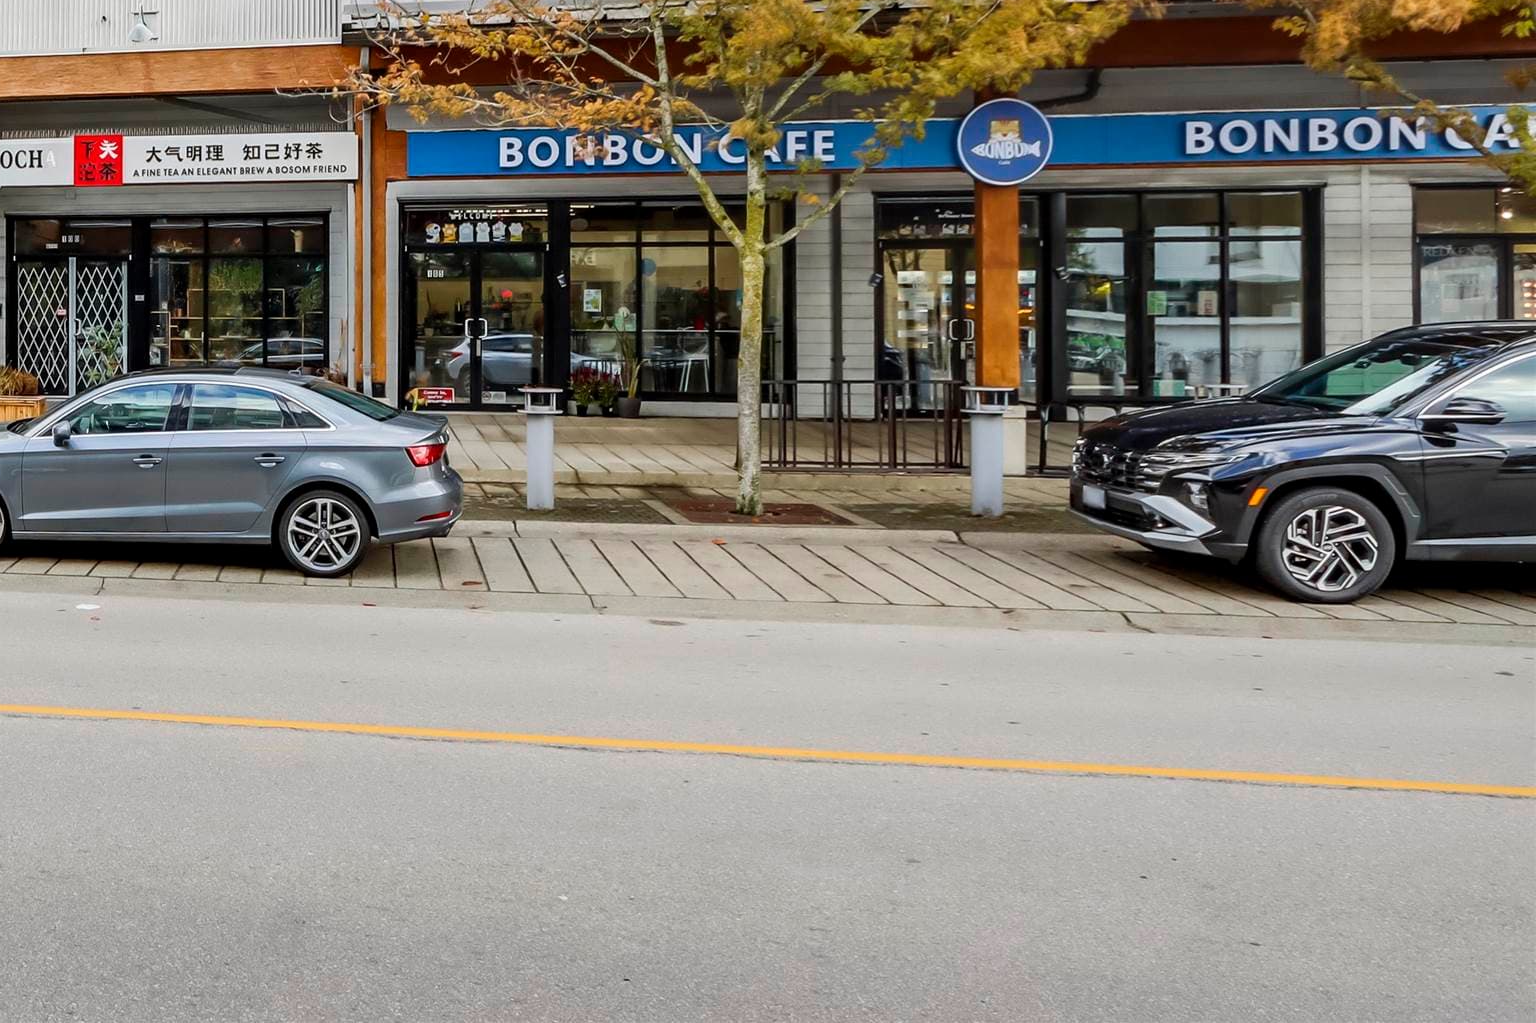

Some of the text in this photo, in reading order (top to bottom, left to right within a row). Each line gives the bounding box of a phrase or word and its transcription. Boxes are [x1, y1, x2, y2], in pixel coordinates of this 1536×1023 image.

[1185, 116, 1426, 155] BONBON
[145, 142, 323, 163] 大气明理 知己好茶
[499, 133, 702, 168] BONBON
[133, 164, 347, 177] A FINE TEA AN ELEGANT BREW A BOSOM FRIEND
